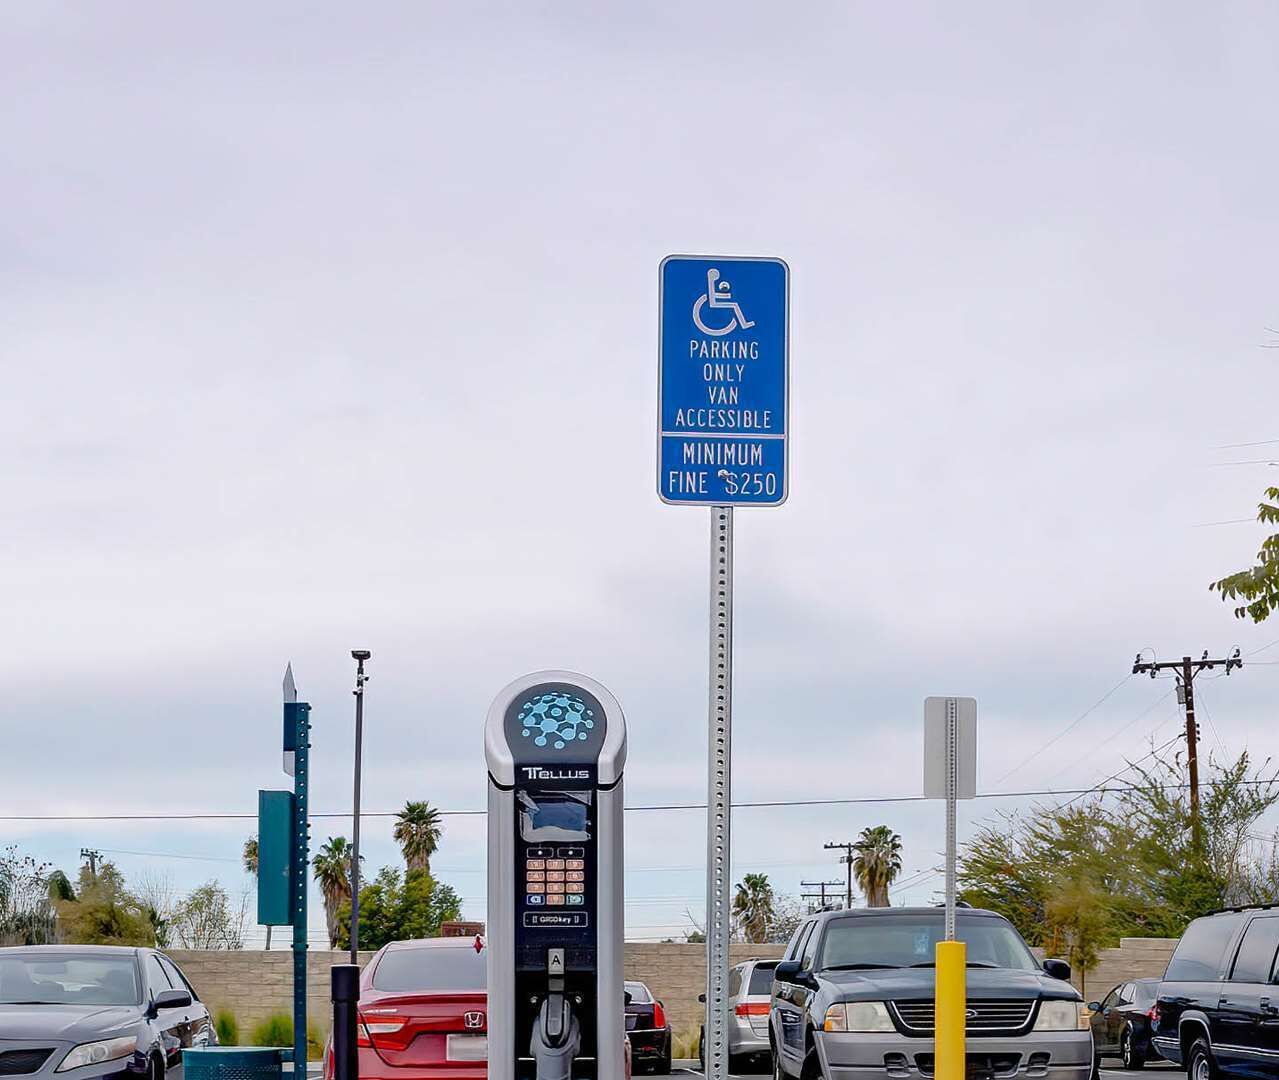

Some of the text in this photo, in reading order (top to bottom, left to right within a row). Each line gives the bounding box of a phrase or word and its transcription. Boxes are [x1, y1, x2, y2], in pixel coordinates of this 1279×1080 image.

[690, 339, 759, 360] PARKING
[703, 363, 744, 382] ONLY
[708, 386, 738, 405] VAN
[675, 408, 772, 428] ACCESSIBLE
[683, 442, 763, 466] MINIMUM
[669, 471, 776, 496] FINE $250
[551, 954, 561, 965] A
